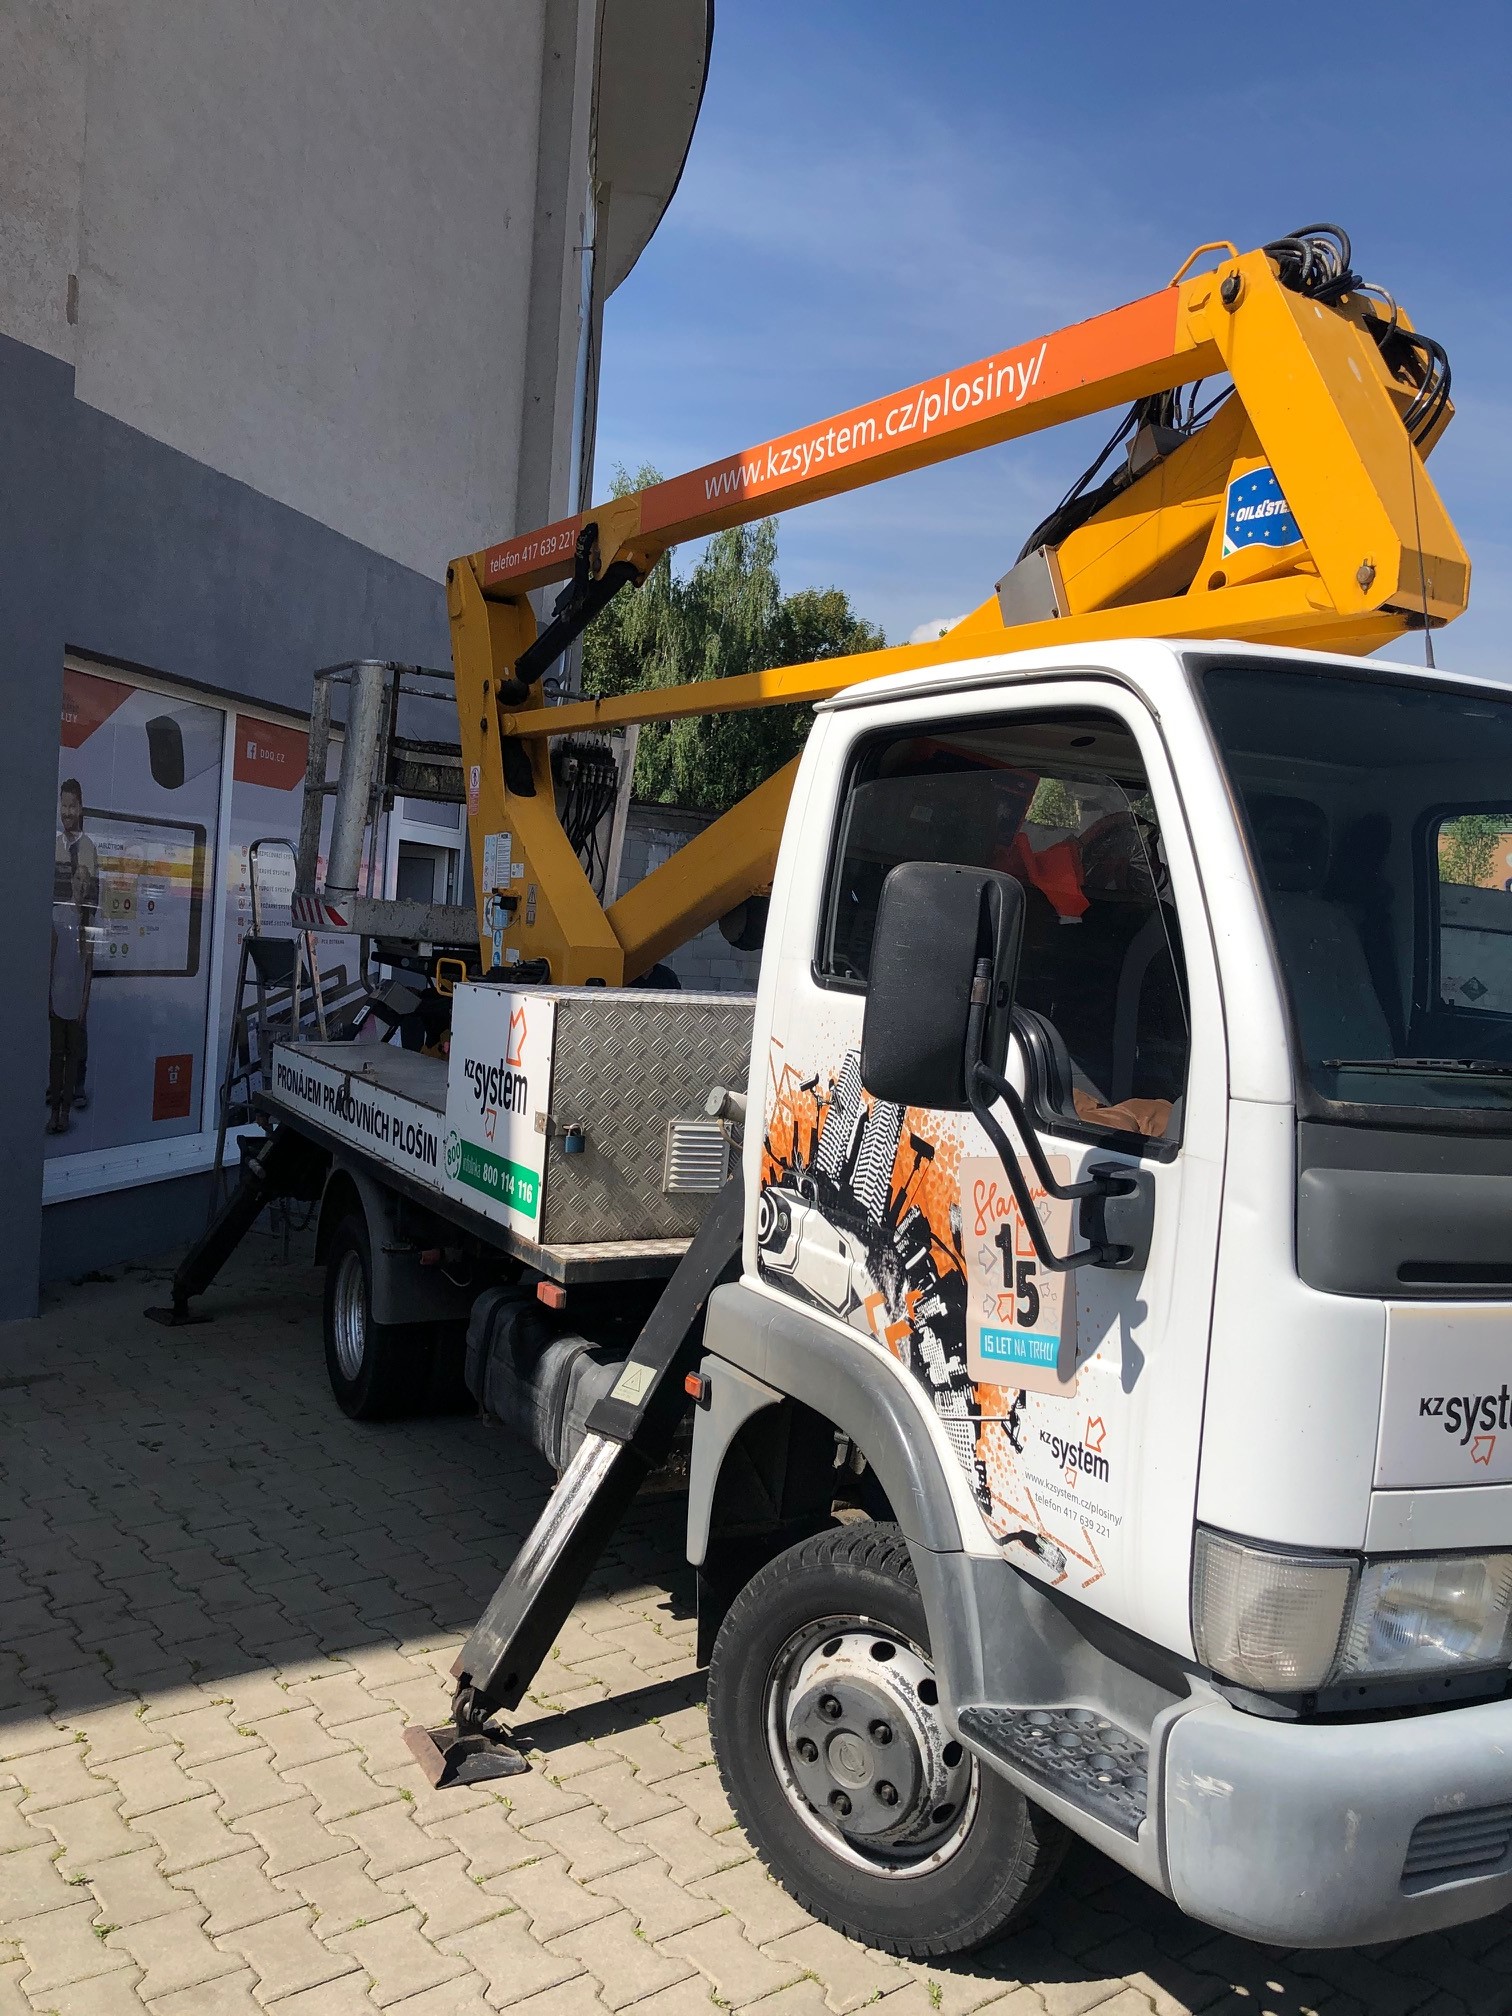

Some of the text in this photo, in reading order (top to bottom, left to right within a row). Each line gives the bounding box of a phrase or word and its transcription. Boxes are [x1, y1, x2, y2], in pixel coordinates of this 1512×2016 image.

[705, 343, 1048, 500] www.kzsystem.cz/plosiny/
[490, 529, 575, 573] telefon 417 639 221
[277, 1063, 322, 1107] PRONÁJEM
[323, 1084, 389, 1143] PRACOVNÍCH
[392, 1117, 438, 1168] PLOŠIN
[447, 1142, 461, 1166] 800
[482, 1163, 498, 1186] 800
[501, 1172, 515, 1195] 114
[518, 1179, 533, 1204] 116
[984, 1334, 1054, 1362] 15 LET NA TRHU
[1444, 1384, 1512, 1446] syst
[1024, 1470, 1122, 1527] www.kzsystem.cz/plosiny/
[1035, 1492, 1110, 1539] telefon 417 639 221
